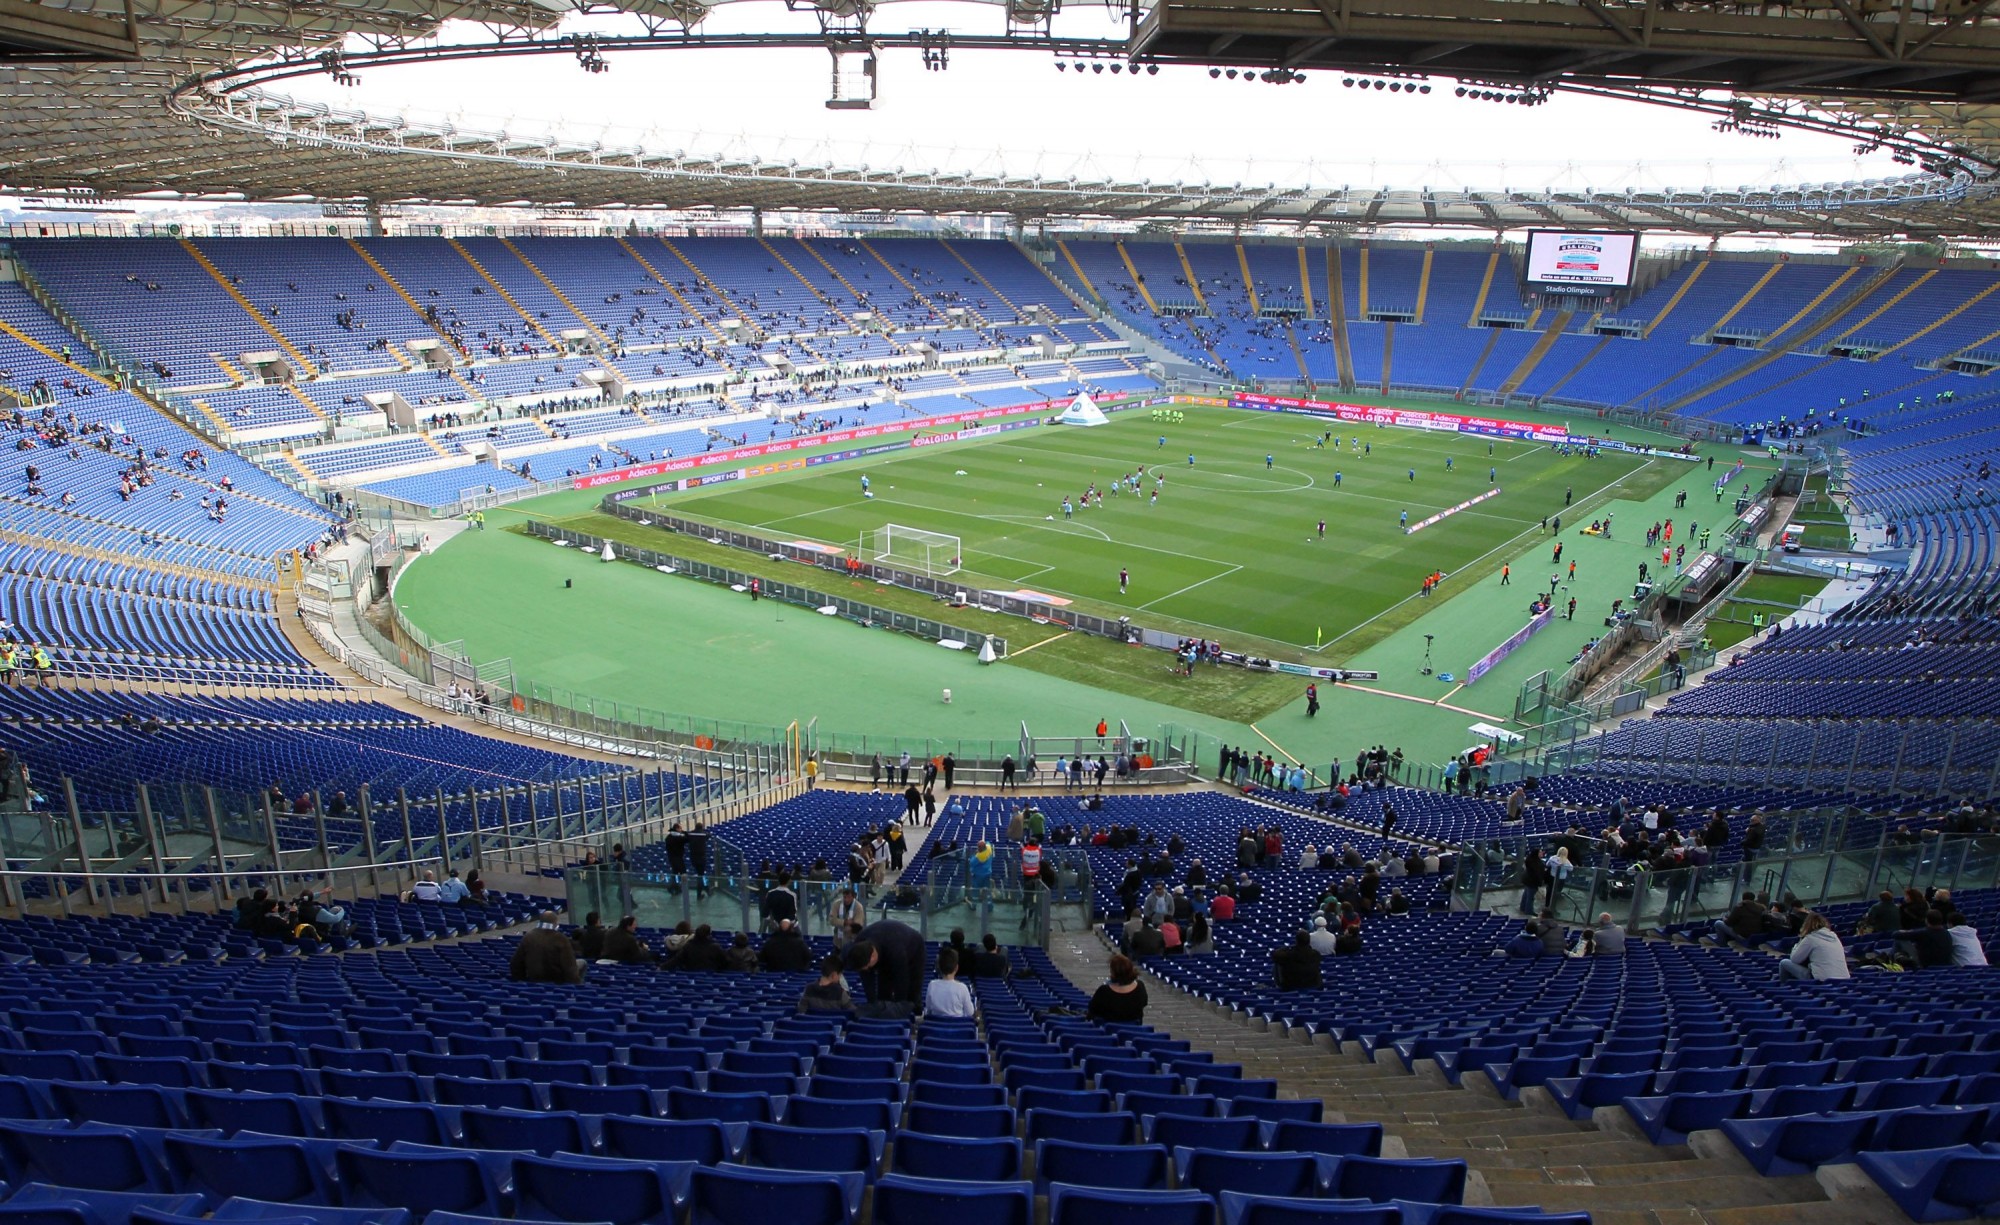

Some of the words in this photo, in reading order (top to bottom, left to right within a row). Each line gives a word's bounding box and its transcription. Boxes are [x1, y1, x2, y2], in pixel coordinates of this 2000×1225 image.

[1566, 286, 1594, 294] Olimpico
[1353, 412, 1393, 423] ALGIDA
[1434, 414, 1461, 423] Adecco
[1468, 418, 1496, 427] Adecco
[1504, 422, 1533, 431] Adecco
[925, 434, 955, 444] ALGIDA
[1532, 432, 1568, 443] Climanet
[590, 474, 620, 486] Adecco
[628, 468, 658, 478] Adecco
[665, 460, 694, 472] Adecco
[700, 455, 728, 465] Adecco
[734, 449, 760, 458] Adecco
[766, 443, 791, 453] Adecco
[797, 438, 821, 447] Adecco
[827, 433, 850, 442] Adecco
[855, 429, 877, 438] Adecco
[883, 424, 904, 433] Adecco
[909, 421, 930, 429] Adecco
[687, 478, 701, 487] sky
[702, 474, 725, 484] SPORT
[656, 484, 672, 492] MSC
[621, 490, 638, 499] MSC
